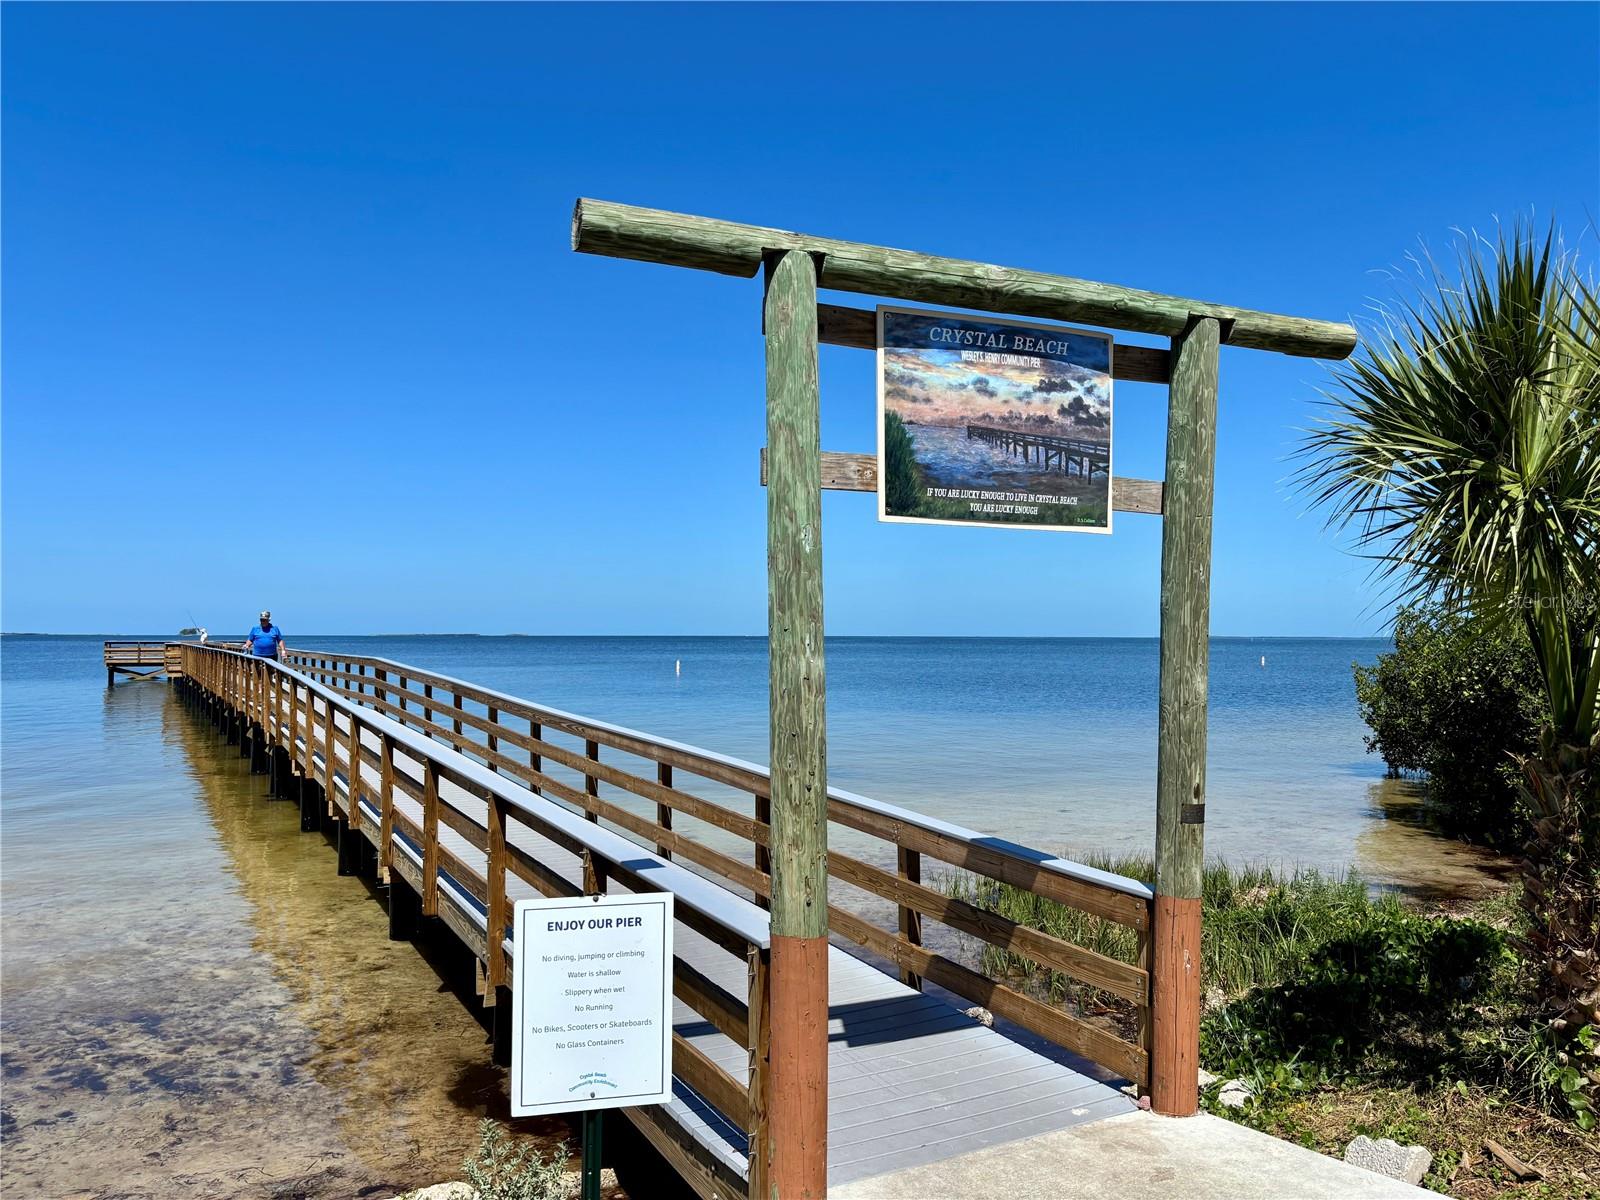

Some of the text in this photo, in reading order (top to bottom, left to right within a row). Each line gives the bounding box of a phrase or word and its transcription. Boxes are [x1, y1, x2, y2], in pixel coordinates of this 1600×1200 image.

[929, 327, 1069, 356] CRYSTAL BEACH
[985, 352, 1000, 365] HENRY
[1000, 353, 1030, 368] COMMUNITY
[1030, 356, 1041, 369] PIER
[926, 487, 1078, 506] IF YOU ARE LUCKY ENOUGH TO LIVE IN CRYSTAL BEACH
[969, 502, 1039, 515] YOU ARE LUCKY ENOUGH
[547, 916, 643, 932] ENJOY OUR PIER
[542, 954, 552, 962] No
[553, 953, 577, 963] diving,
[577, 951, 606, 962] jumping
[615, 949, 645, 959] climbing
[595, 968, 622, 977] shallow
[564, 985, 626, 997] Slippery when wet
[574, 1003, 614, 1012] No Running
[531, 1026, 543, 1034] No
[544, 1025, 566, 1033] Bikes,
[567, 1023, 599, 1032] Scooters
[608, 1018, 653, 1029] Skateboards
[566, 1041, 586, 1049] Glass
[587, 1038, 625, 1047] Containers
